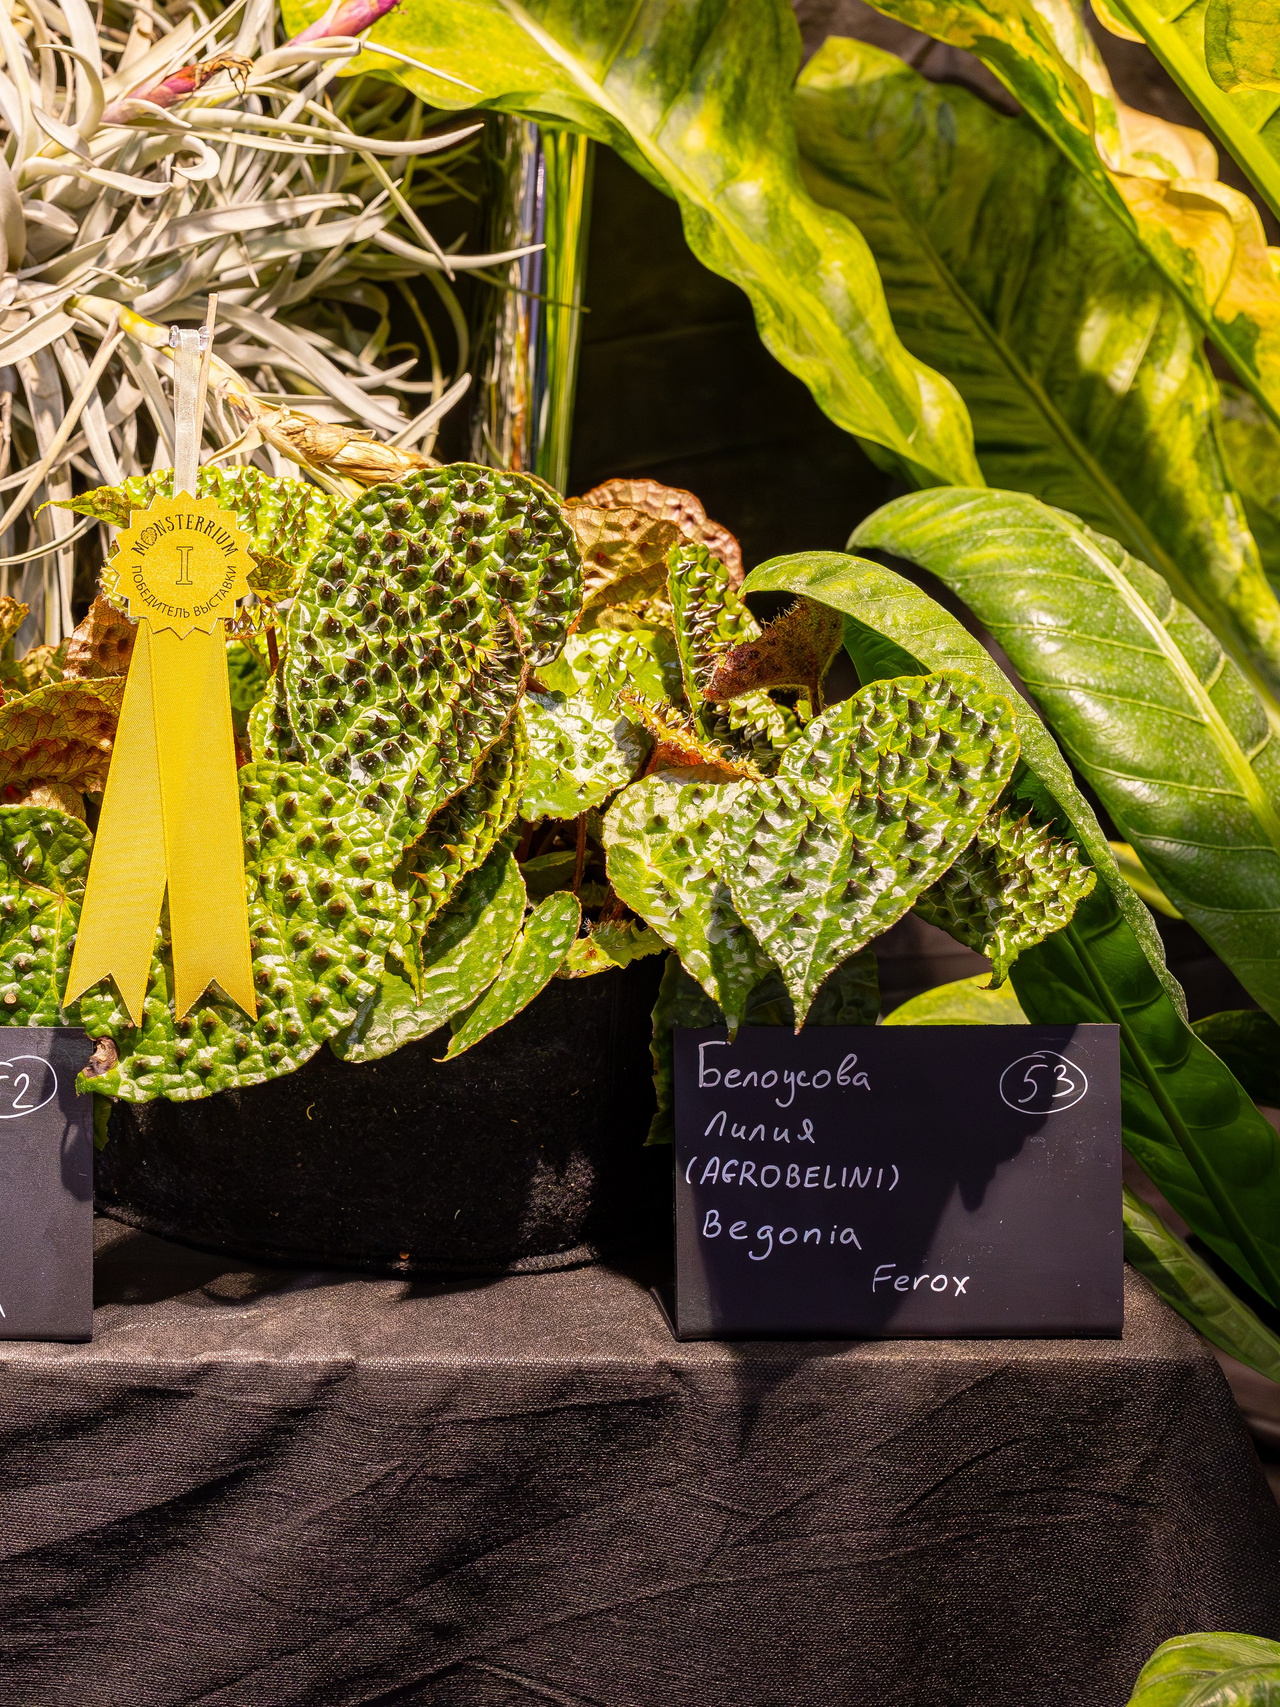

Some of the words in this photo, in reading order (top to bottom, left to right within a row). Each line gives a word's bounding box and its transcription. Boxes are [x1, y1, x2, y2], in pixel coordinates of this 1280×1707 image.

[131, 514, 239, 557] MONSTERRIUM
[131, 565, 190, 618] ПОБЕДИТЕЛЬ
[193, 565, 237, 617] ВЫСТАВКИ
[698, 1041, 871, 1108] Белоусова
[1018, 1063, 1076, 1103] 53
[704, 1110, 815, 1144] Лилия
[685, 1156, 899, 1191] (AGROBELINI)
[702, 1209, 862, 1261] Begonia
[872, 1263, 971, 1297] Ferox
